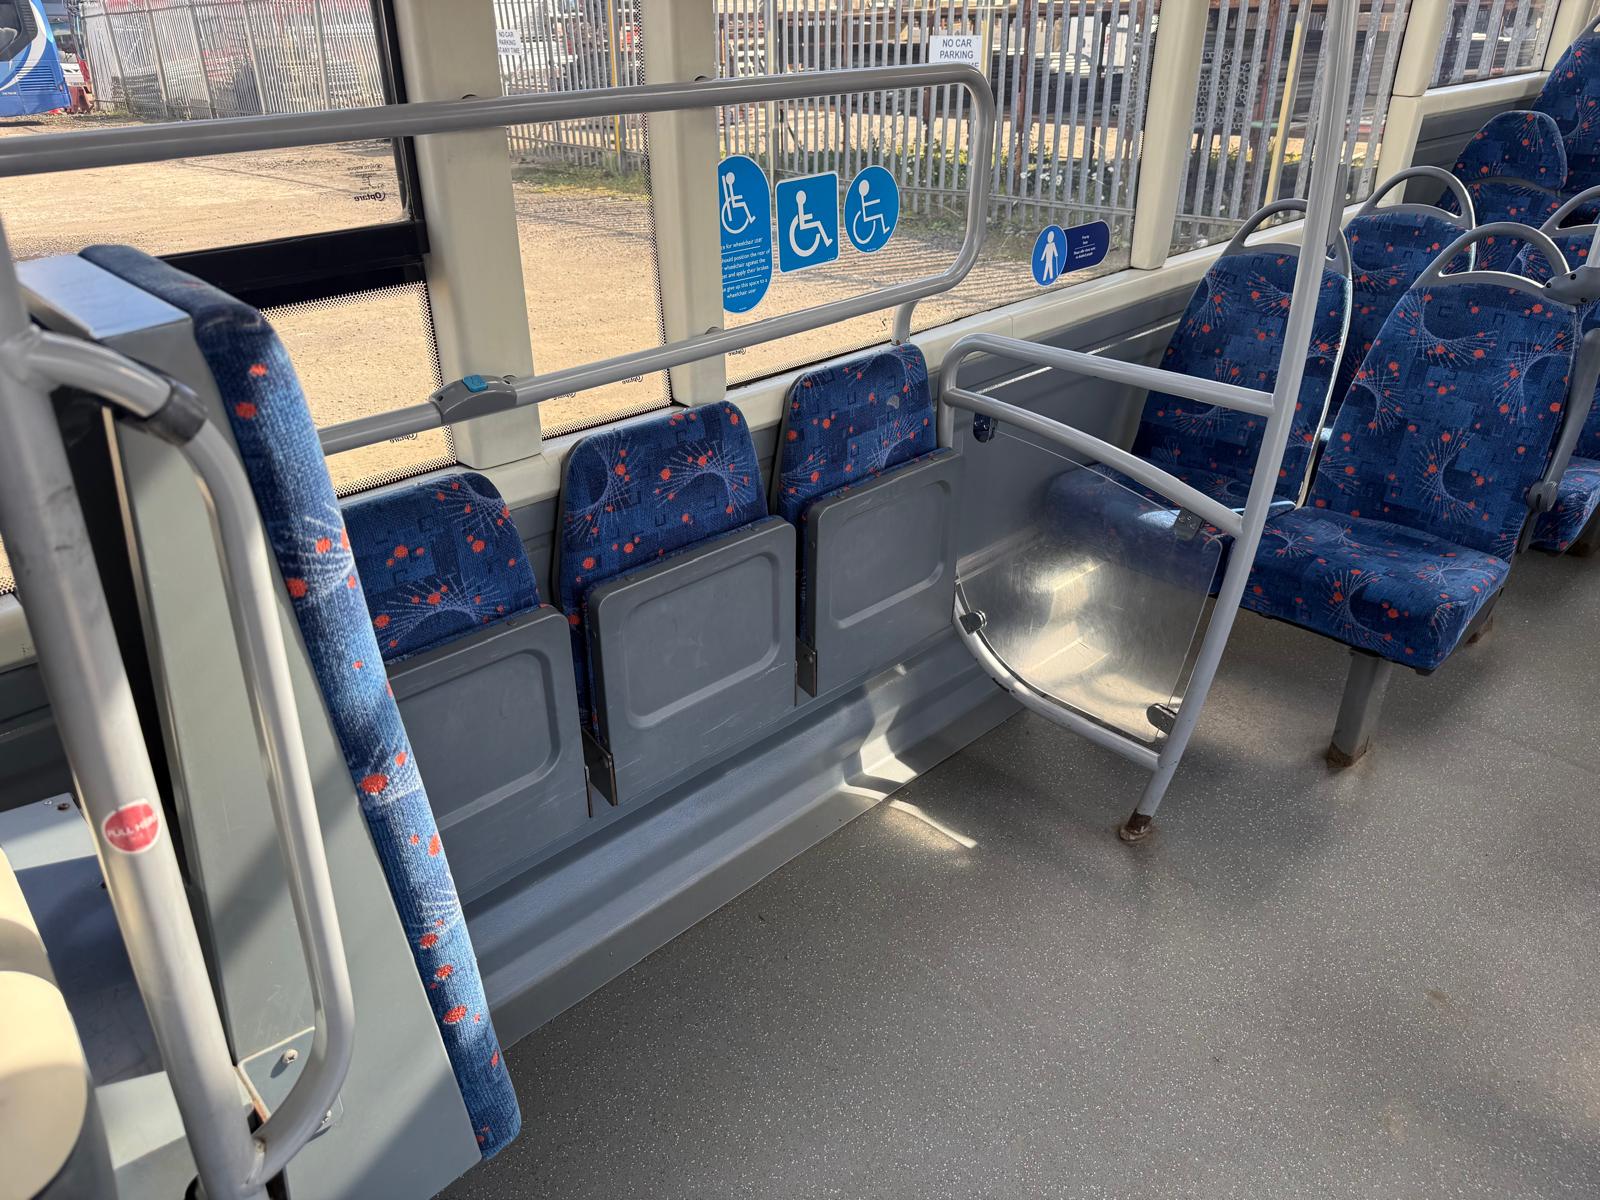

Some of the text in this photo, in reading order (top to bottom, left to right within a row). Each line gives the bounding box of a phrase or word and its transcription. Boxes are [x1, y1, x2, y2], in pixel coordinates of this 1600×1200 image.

[942, 38, 972, 48] NO CAR
[939, 50, 974, 59] PARKING
[732, 240, 754, 248] wheelchair
[734, 253, 750, 262] position
[724, 263, 745, 271] wheelchair
[745, 260, 759, 268] against
[727, 290, 747, 298] wheelchair
